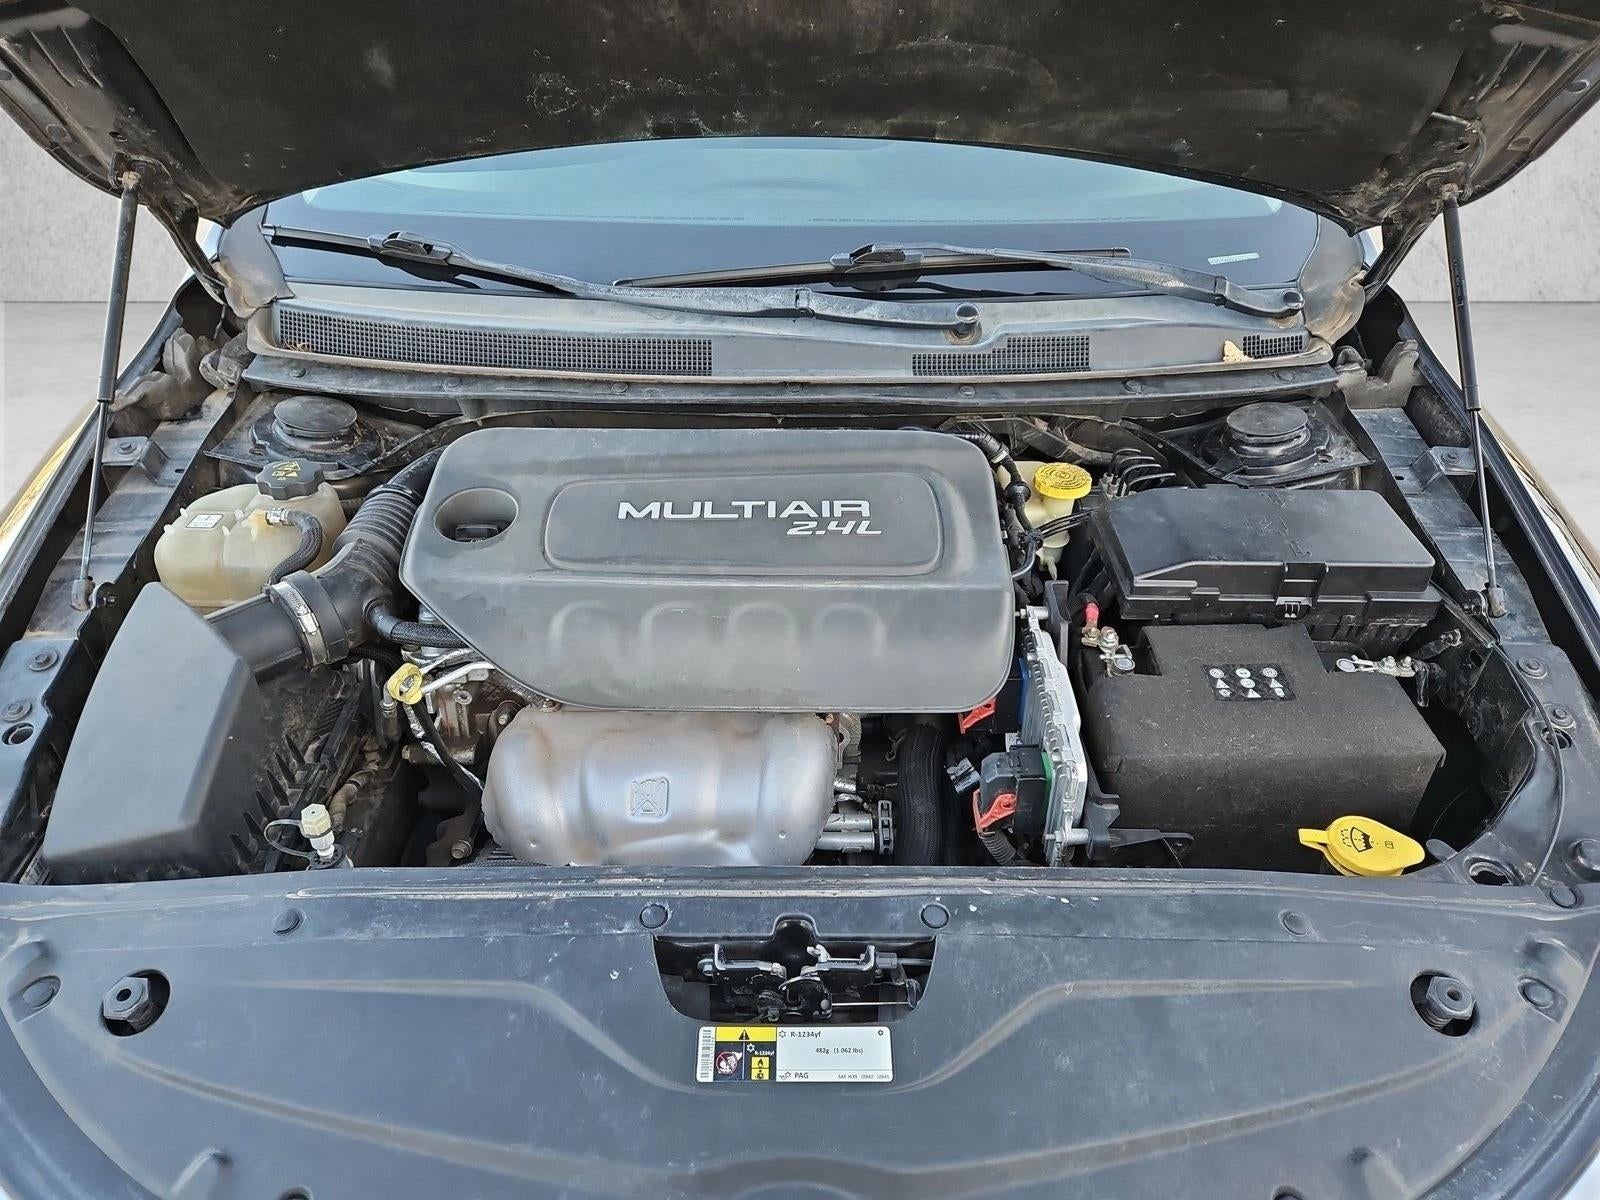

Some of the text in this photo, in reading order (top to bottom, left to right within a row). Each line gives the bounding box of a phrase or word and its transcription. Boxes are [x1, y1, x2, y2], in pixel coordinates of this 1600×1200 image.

[617, 500, 872, 519] MULTIAIR
[786, 520, 883, 536] 2.4L
[790, 1031, 821, 1039] R-1234yf
[815, 1047, 864, 1055] 482g (1.062 lbs)
